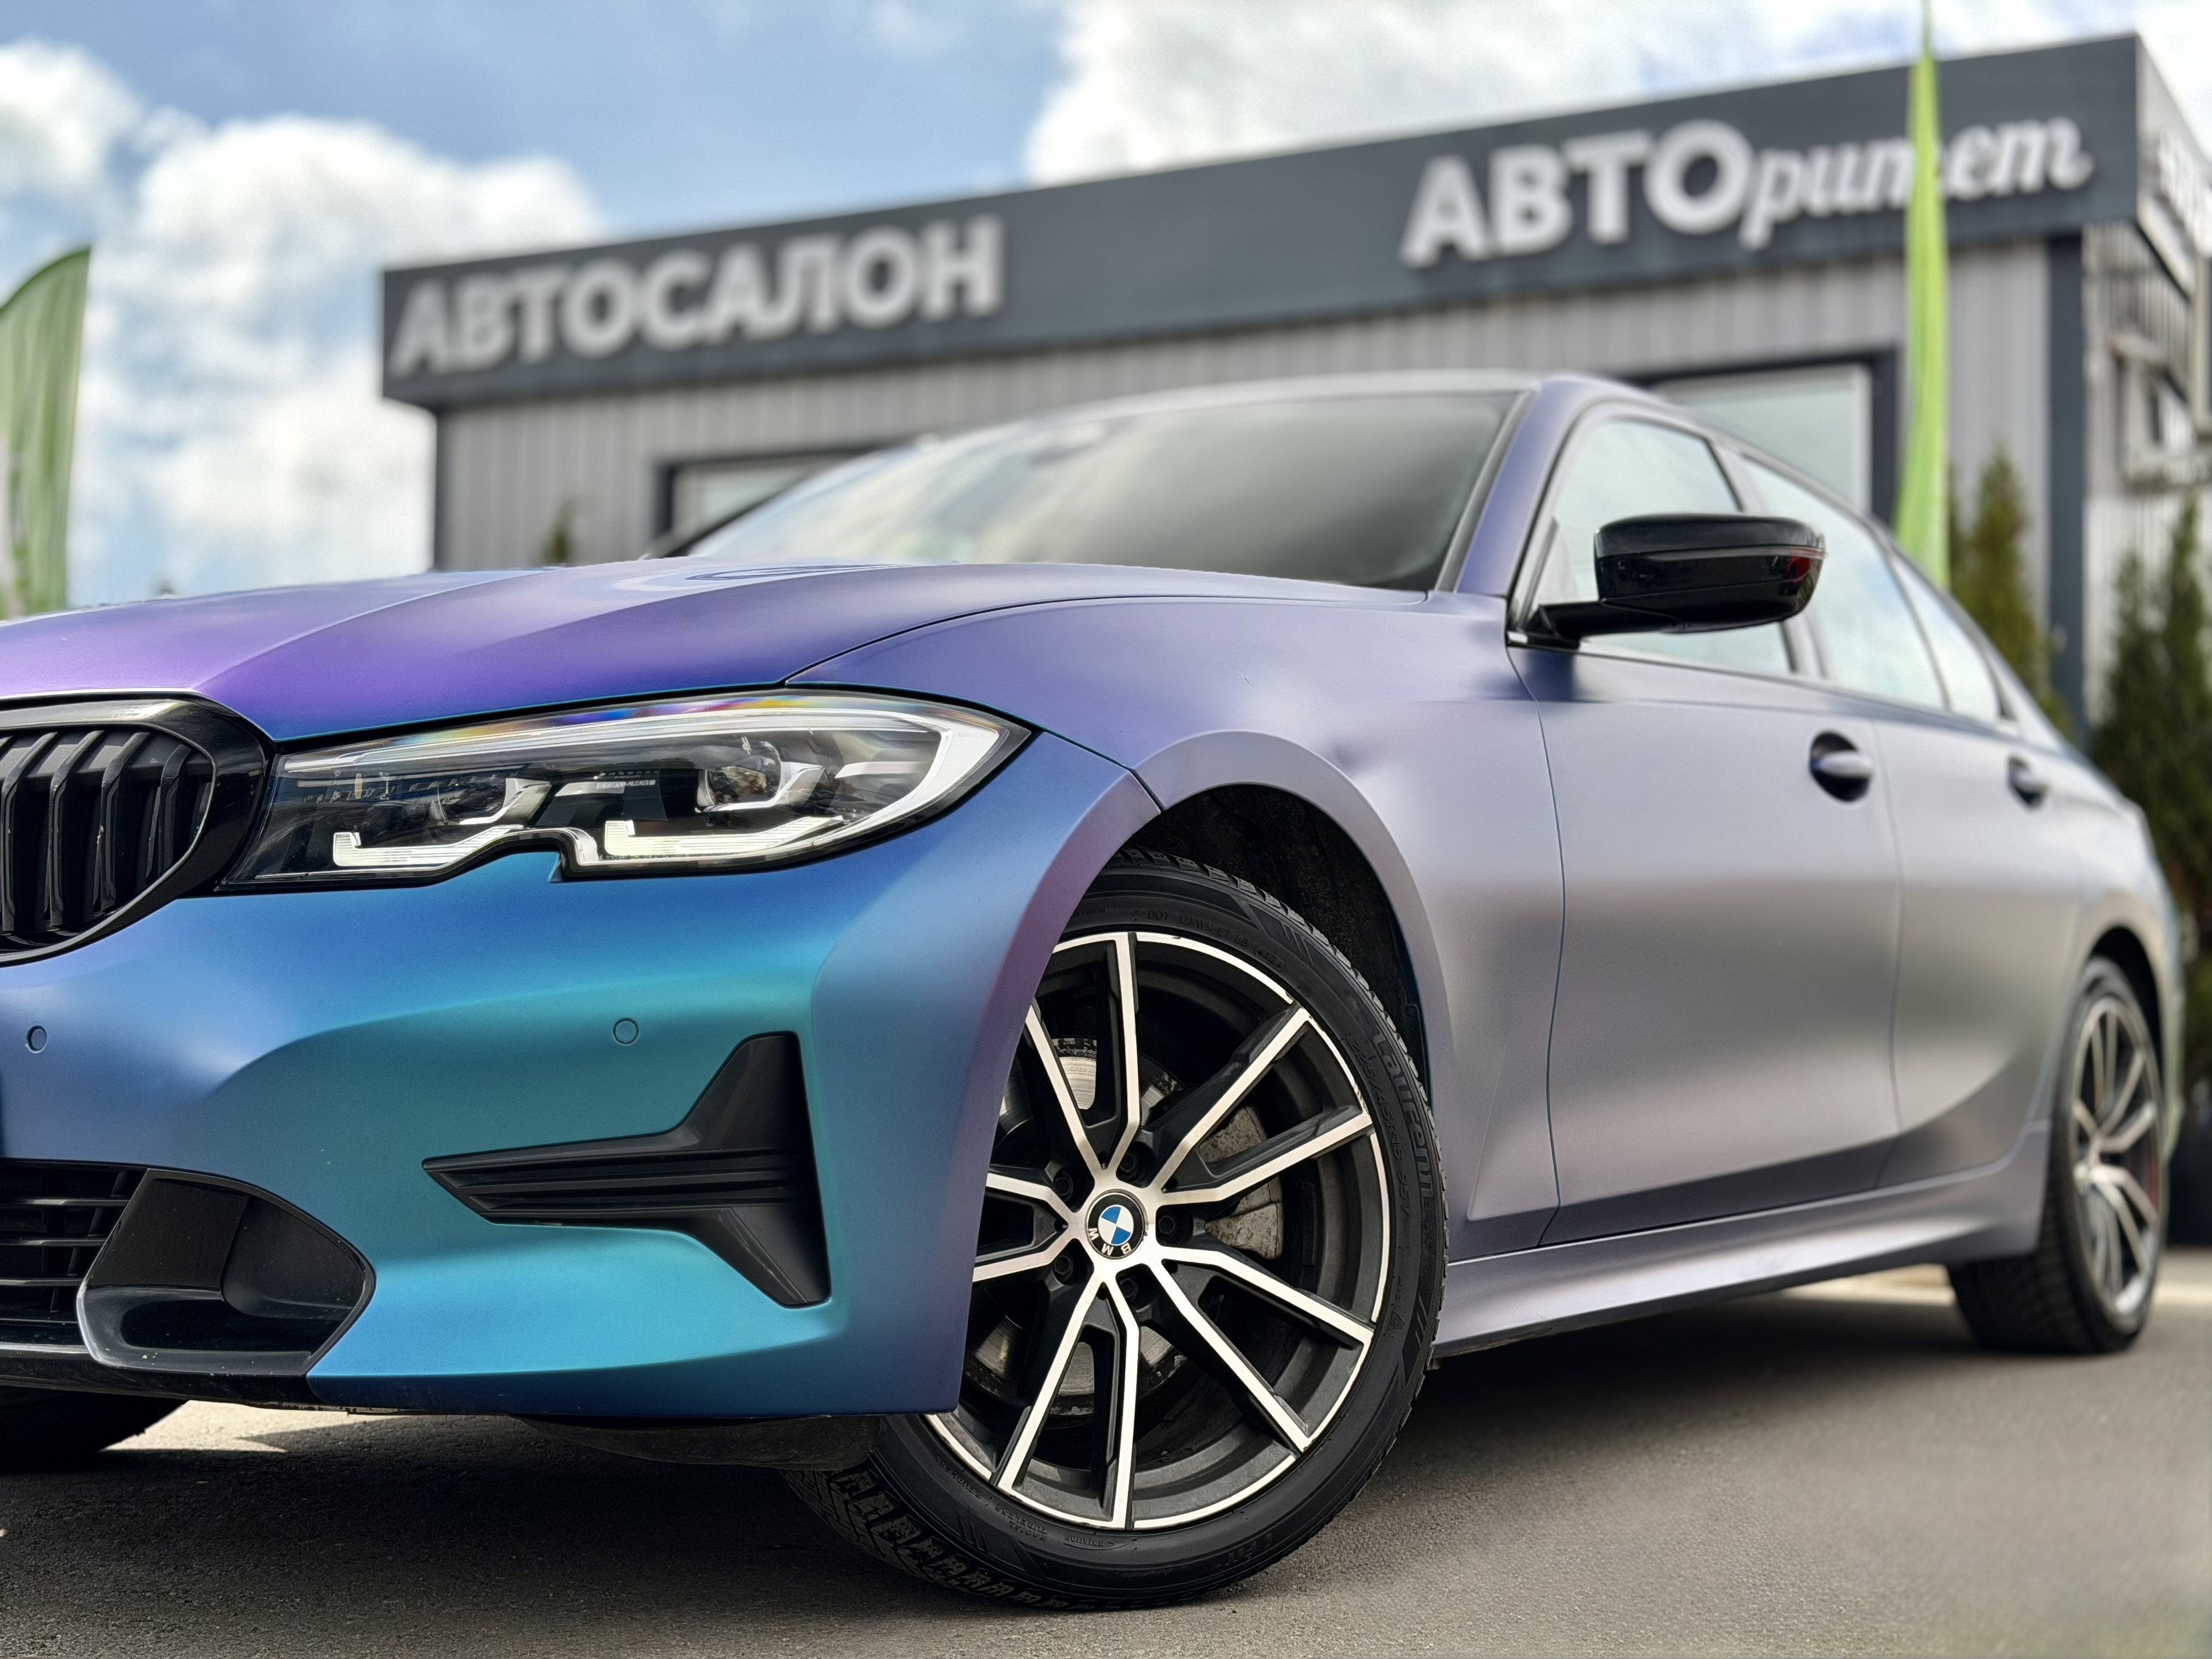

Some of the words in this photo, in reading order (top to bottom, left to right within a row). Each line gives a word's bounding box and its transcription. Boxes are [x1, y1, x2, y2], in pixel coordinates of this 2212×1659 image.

[388, 215, 1005, 376] АВТОСАЛОН
[1149, 910, 1169, 921] DOT
[1373, 1033, 1435, 1199] Laufenn
[1088, 1228, 1132, 1256] BMW
[935, 1455, 984, 1500] STUDLESS
[994, 1505, 1048, 1534] TUBELESS
